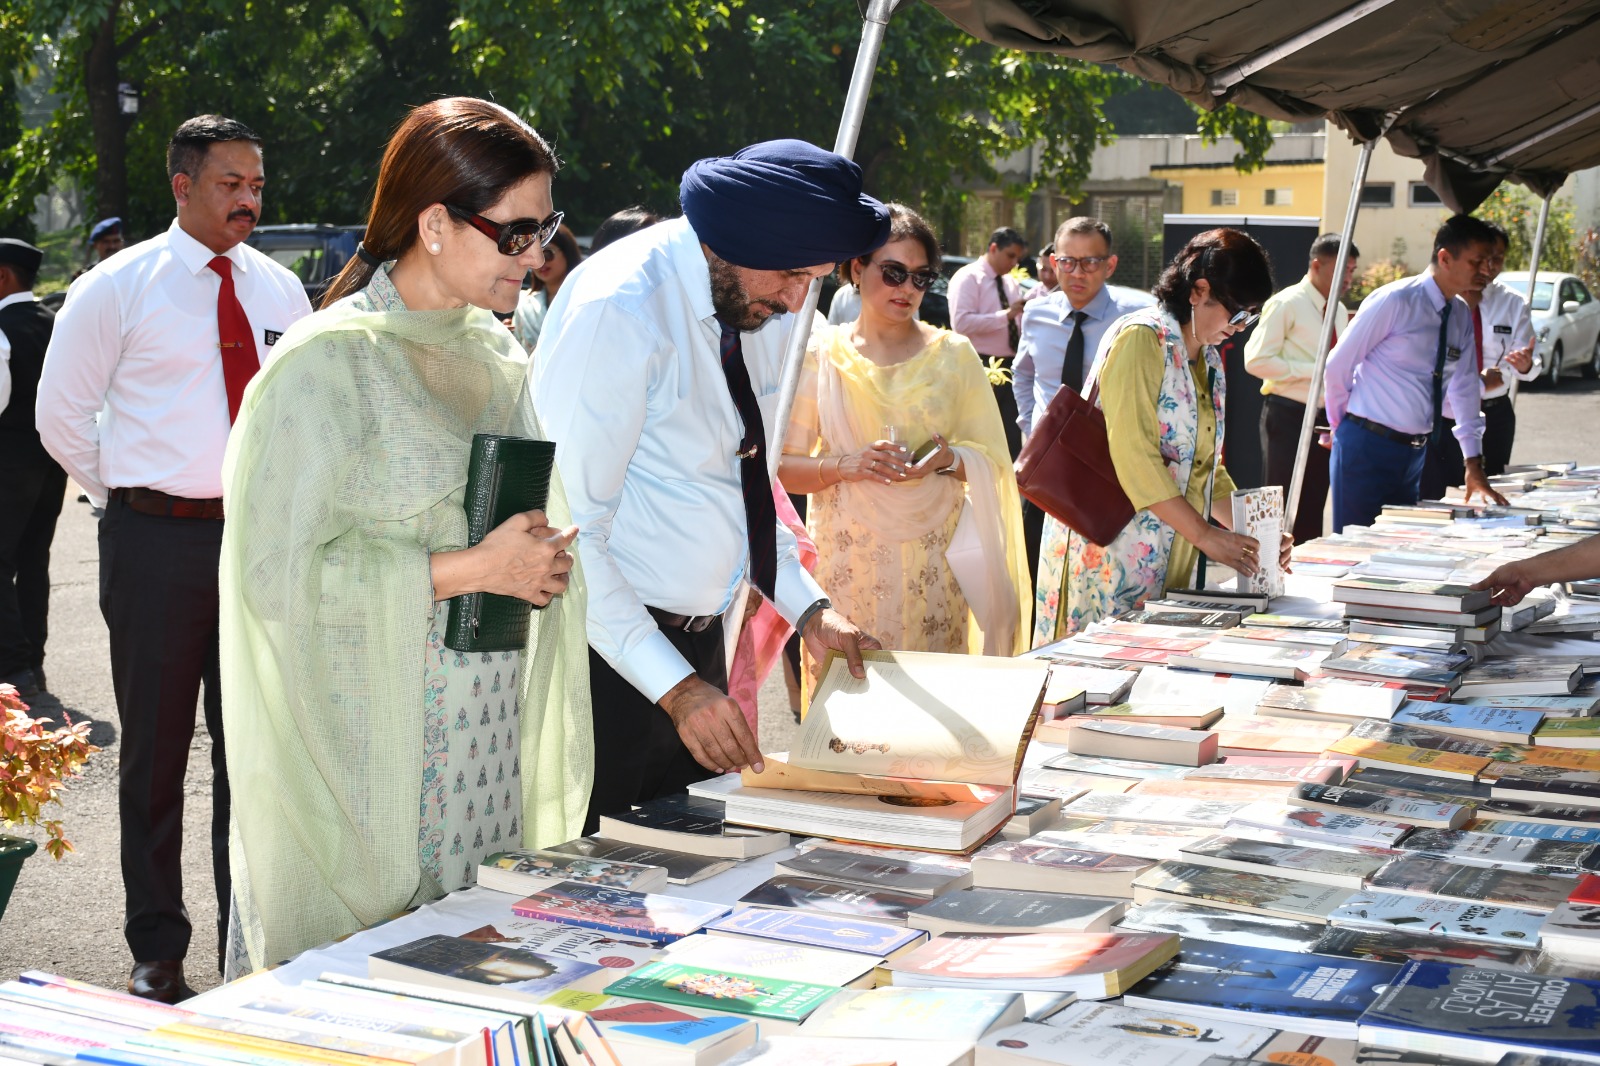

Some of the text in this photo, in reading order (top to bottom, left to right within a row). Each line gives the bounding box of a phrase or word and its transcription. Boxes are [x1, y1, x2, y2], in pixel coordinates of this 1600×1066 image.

[1440, 978, 1493, 1014] WORLD
[1481, 971, 1497, 980] OF
[1475, 973, 1542, 1020] ATLAS
[1523, 979, 1571, 1025] COMPLETE
